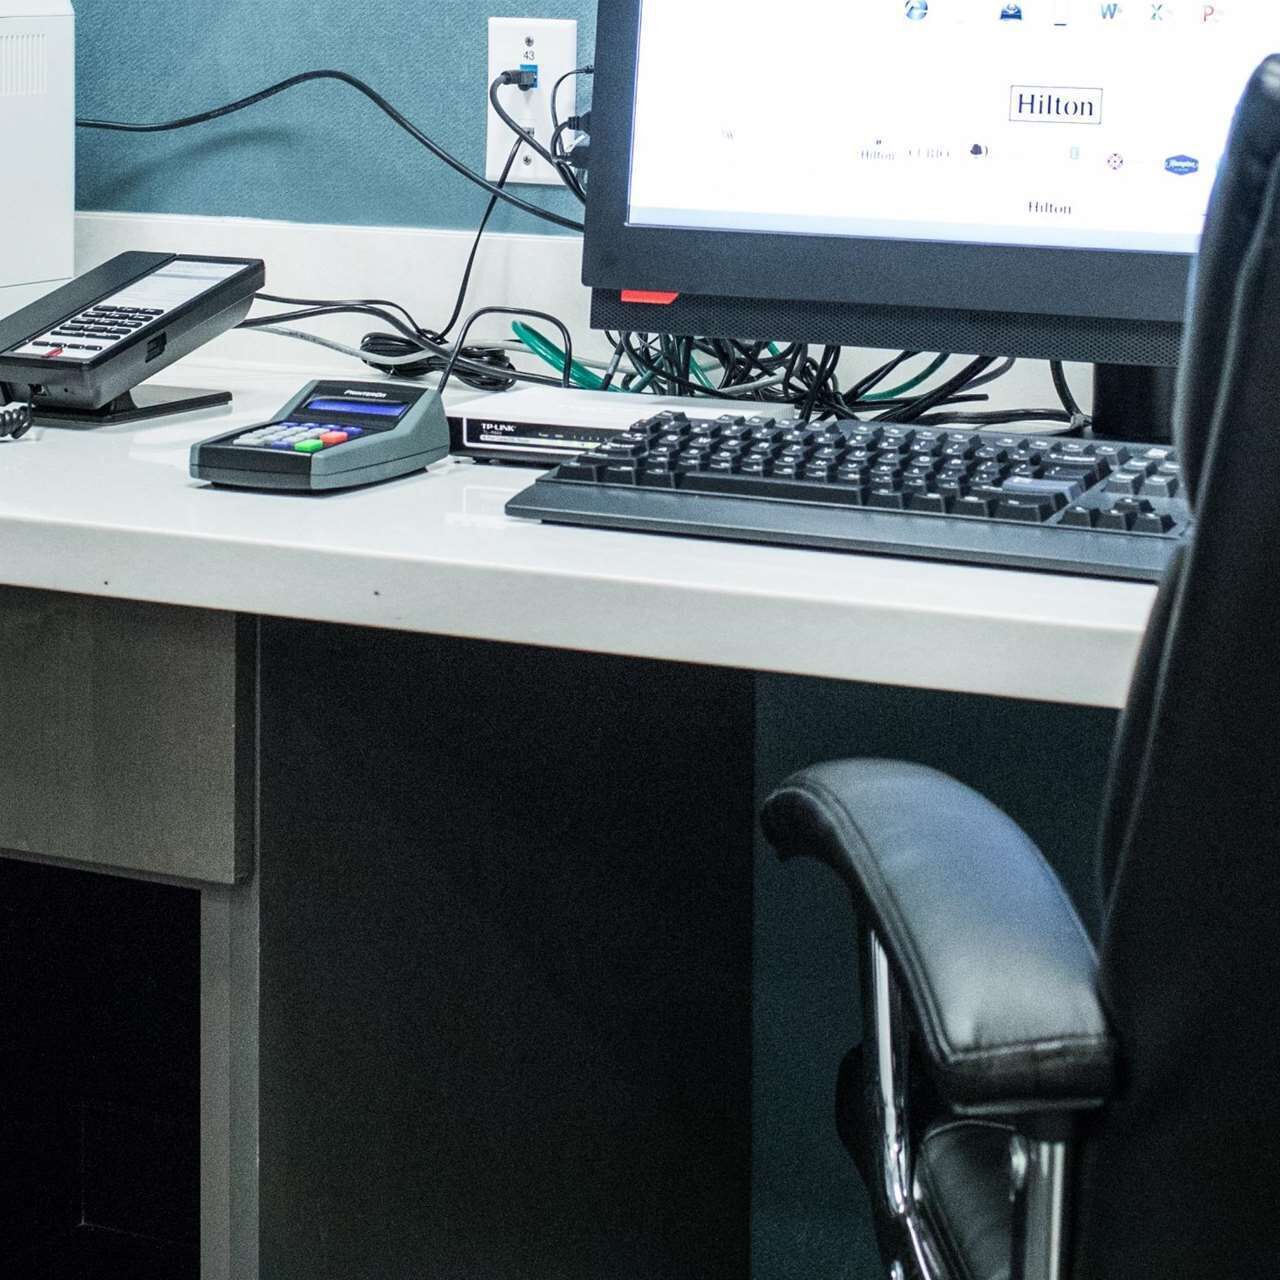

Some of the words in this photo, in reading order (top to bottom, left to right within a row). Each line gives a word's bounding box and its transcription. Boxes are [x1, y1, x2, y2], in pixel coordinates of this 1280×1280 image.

[1018, 93, 1095, 117] Hilton
[1028, 201, 1072, 215] Hilton
[481, 423, 515, 432] TP-LINK
